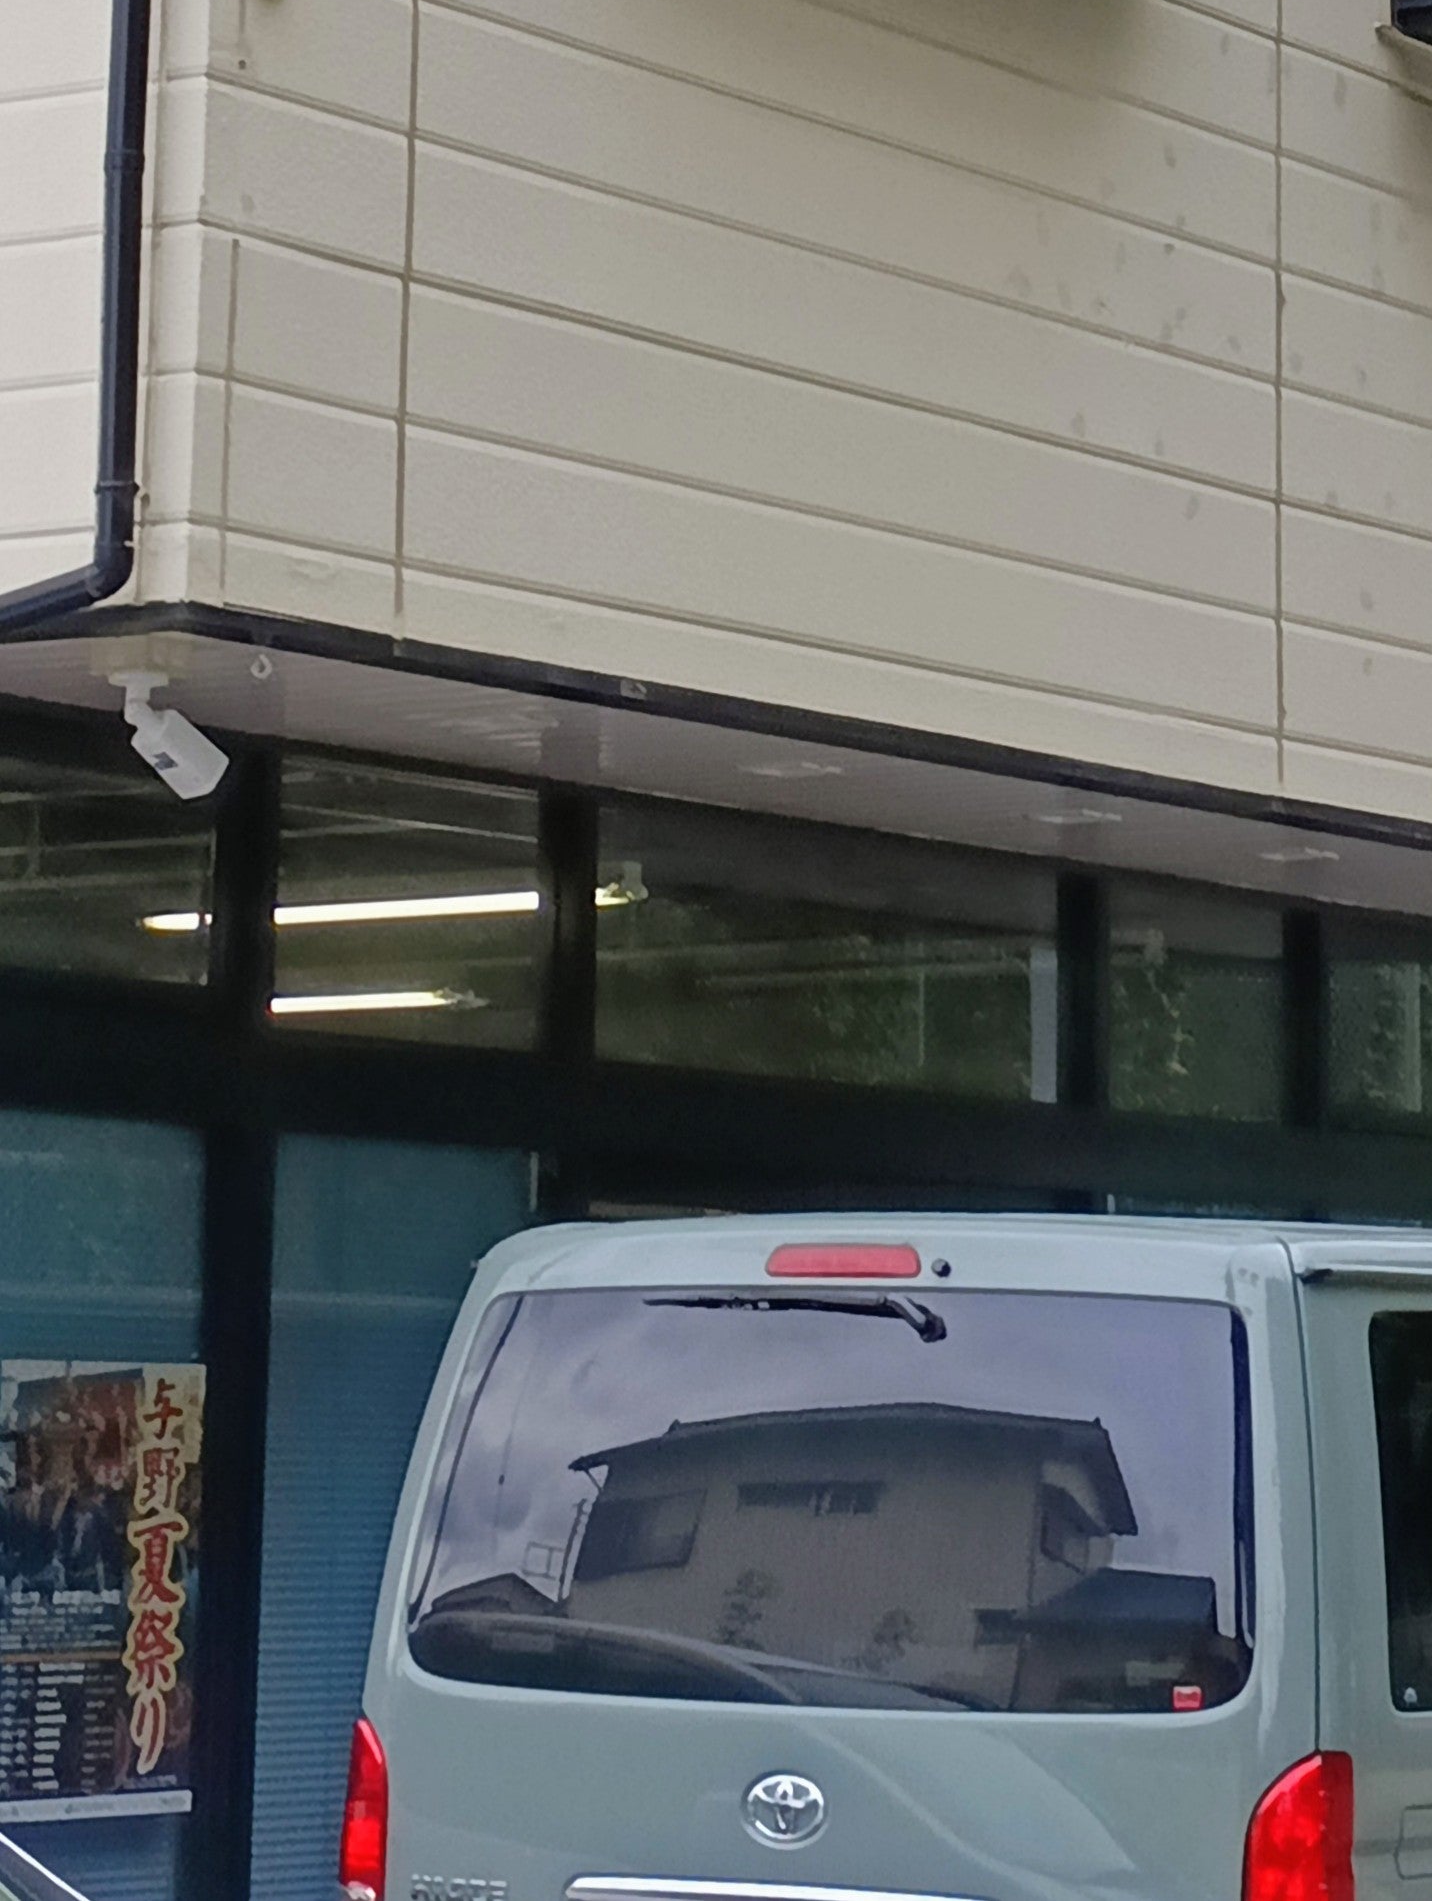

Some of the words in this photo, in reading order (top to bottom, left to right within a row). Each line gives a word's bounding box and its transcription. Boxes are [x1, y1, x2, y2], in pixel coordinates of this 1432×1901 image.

[132, 1378, 184, 1765] 与野夏祭り
